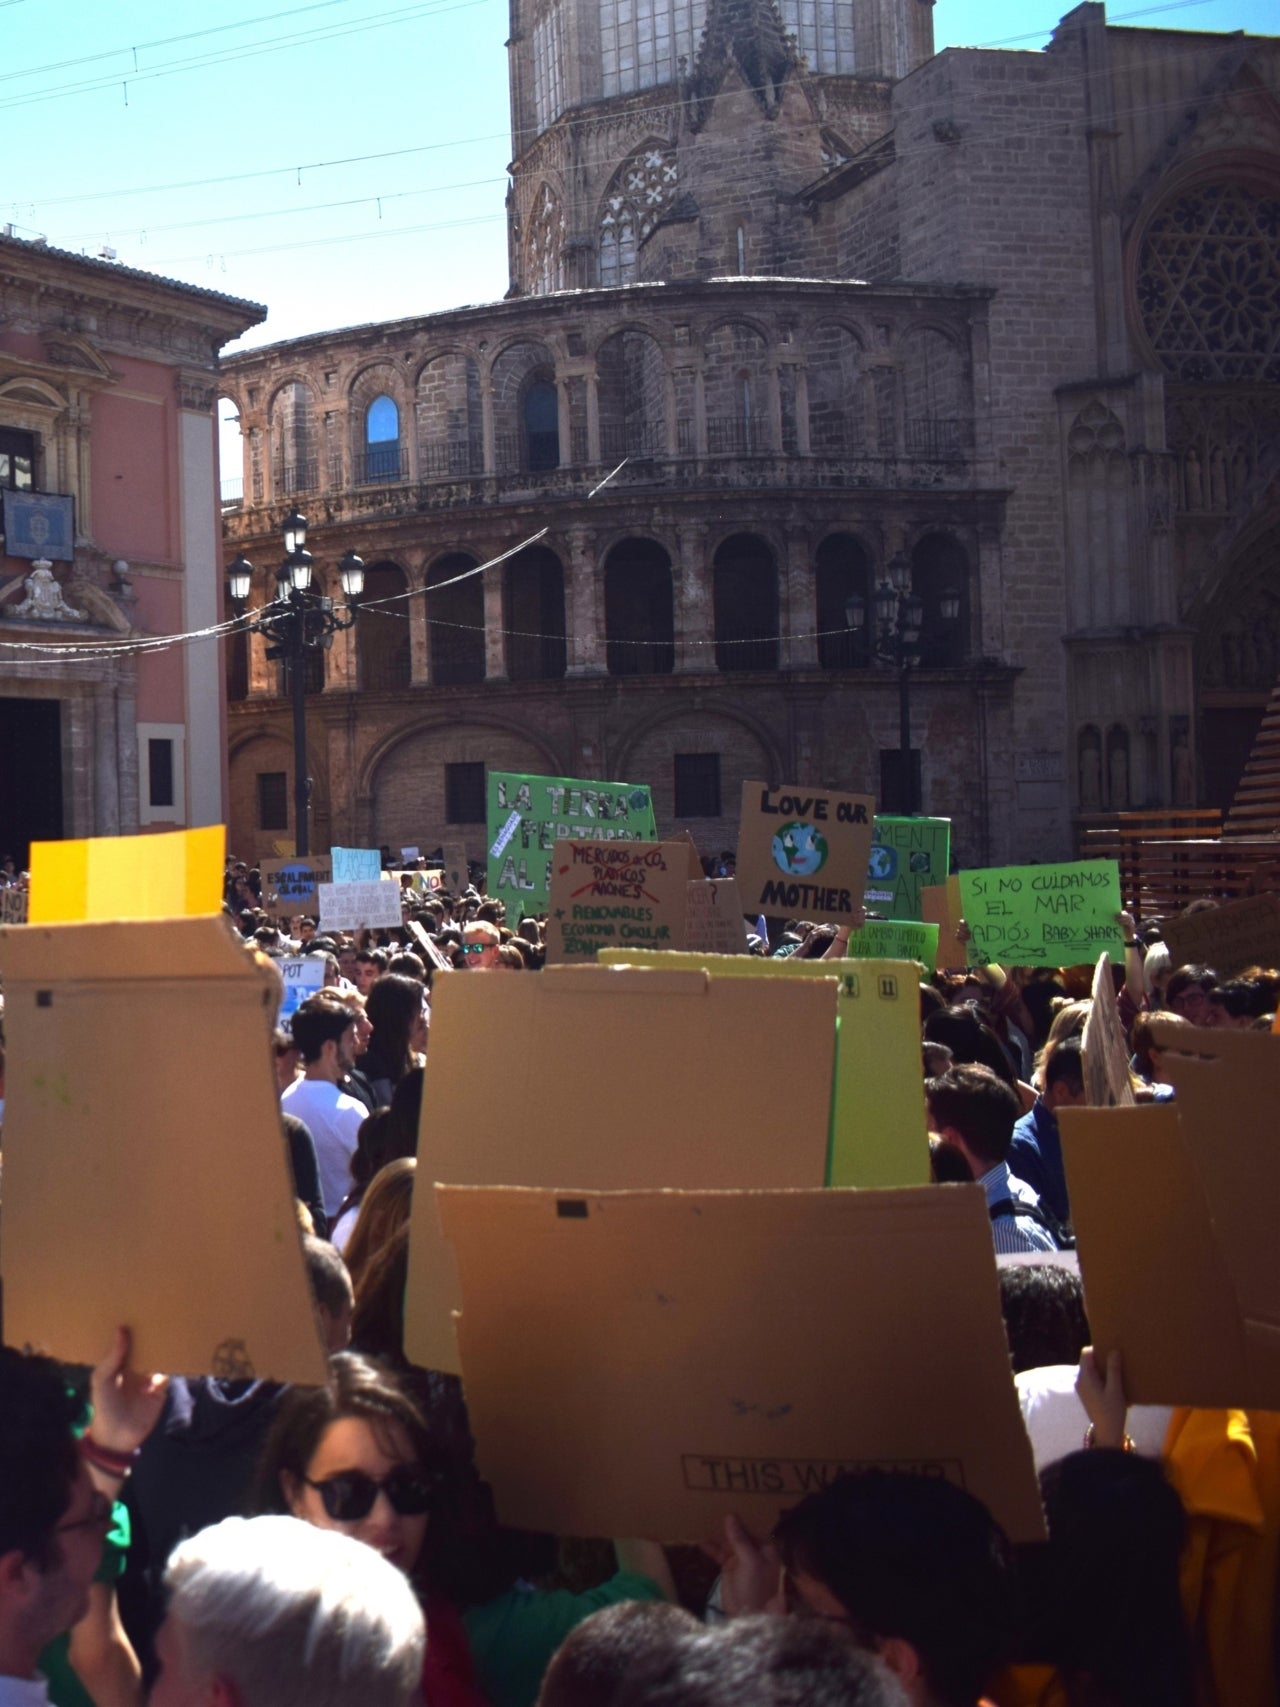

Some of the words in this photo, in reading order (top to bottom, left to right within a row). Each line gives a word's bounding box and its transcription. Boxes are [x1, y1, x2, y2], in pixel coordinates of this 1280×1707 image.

[501, 782, 532, 811] LA
[547, 787, 629, 822] TERRA
[761, 790, 828, 820] LOVE
[837, 801, 868, 824] OUR
[498, 856, 535, 889] AL
[972, 877, 987, 896] SI
[999, 878, 1022, 893] NO
[1032, 871, 1110, 891] CUIDAMOS
[760, 880, 852, 913] MOTHER
[986, 900, 1013, 916] EL
[572, 904, 653, 921] RENOVABLES
[972, 922, 1030, 944] ADIÓS
[1042, 923, 1080, 942] BABY
[1084, 925, 1121, 941] SHARK
[702, 1460, 785, 1491] THIS
